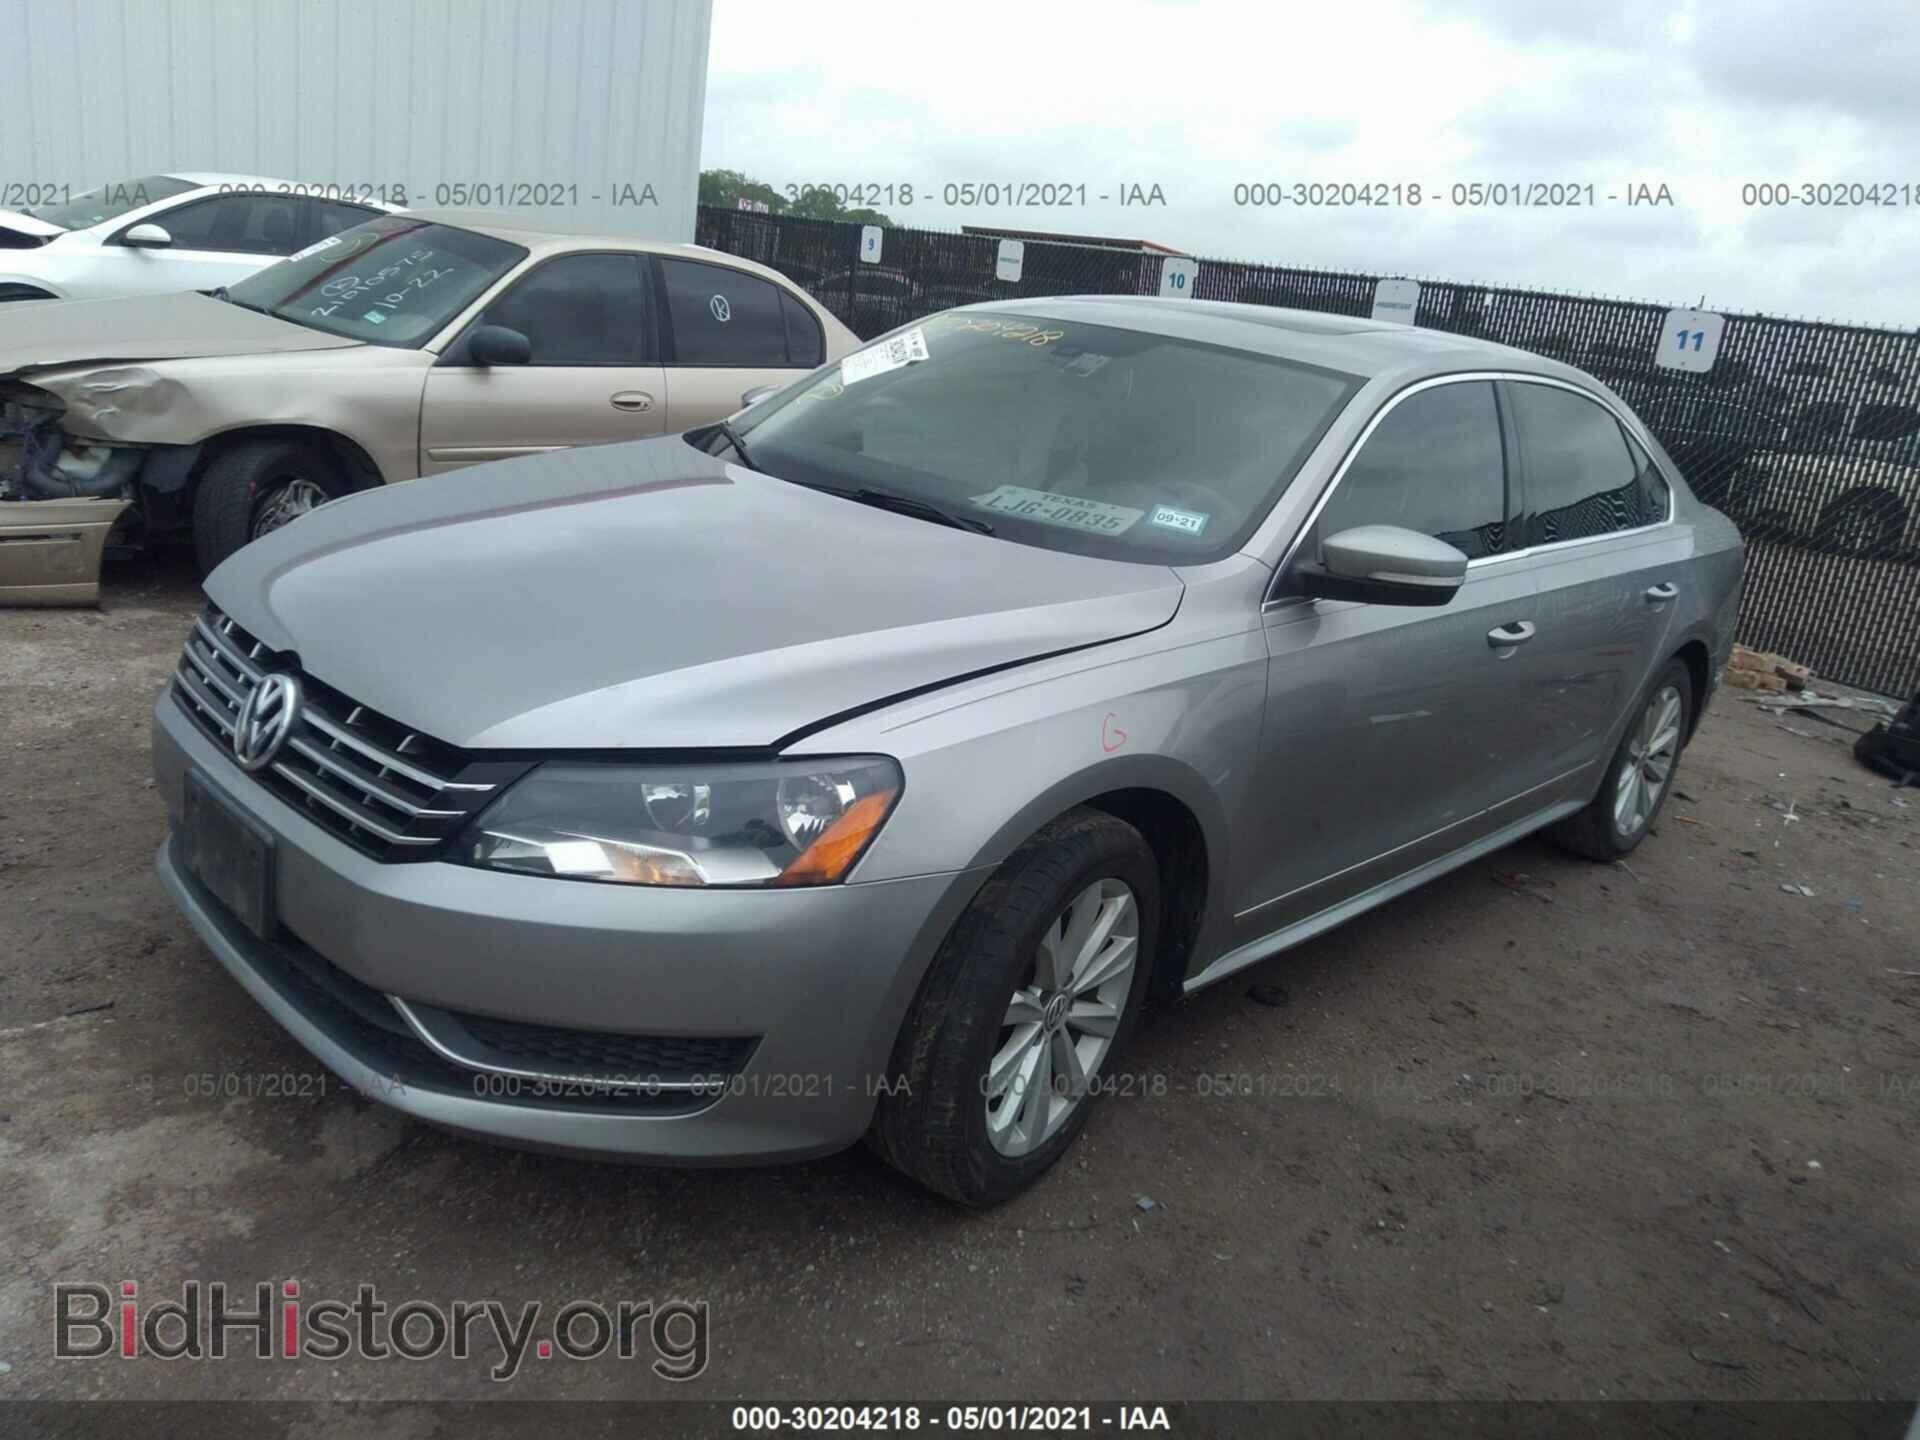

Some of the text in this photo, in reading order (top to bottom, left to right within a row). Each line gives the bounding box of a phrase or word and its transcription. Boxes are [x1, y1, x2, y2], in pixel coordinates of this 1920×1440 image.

[867, 237, 875, 251] 9
[1168, 272, 1185, 289] 10
[1676, 329, 1705, 352] 11
[1042, 494, 1097, 510] TEXAS
